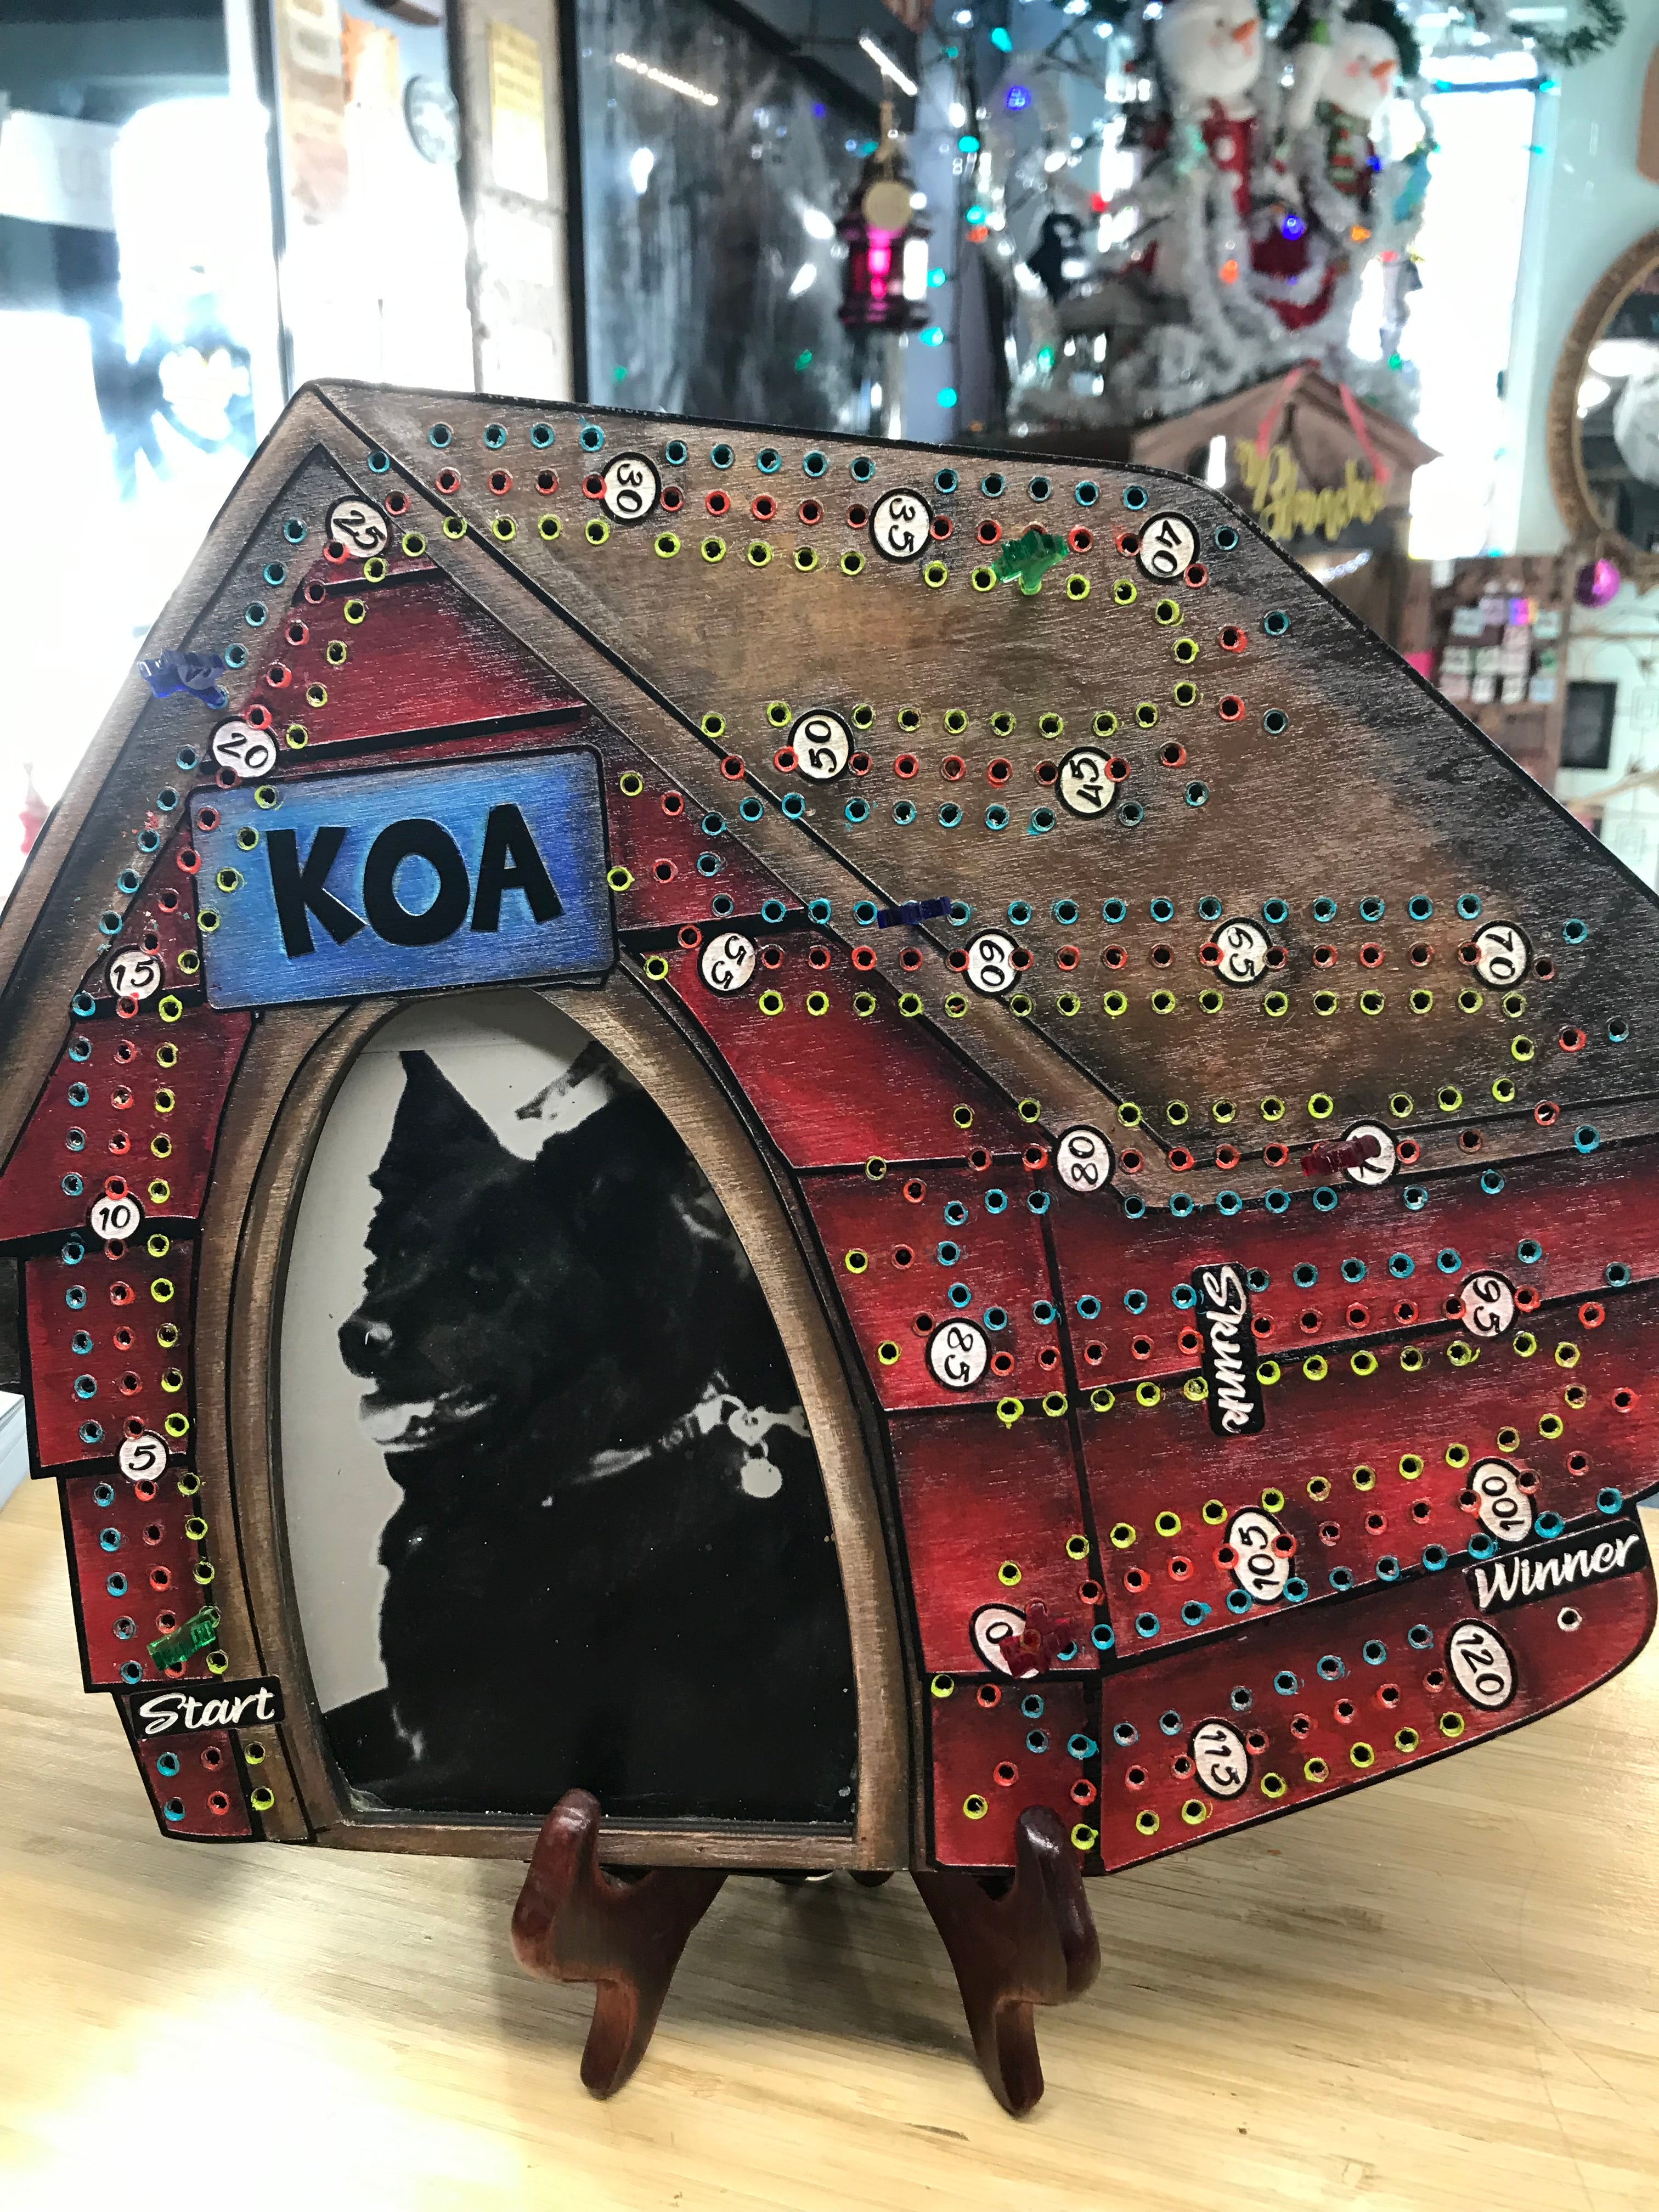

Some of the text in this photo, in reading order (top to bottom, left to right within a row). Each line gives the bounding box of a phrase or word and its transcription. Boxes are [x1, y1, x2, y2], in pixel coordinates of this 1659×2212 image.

[617, 464, 642, 512] 30
[333, 510, 386, 549] 25
[889, 498, 915, 552] 35
[1153, 520, 1182, 573] 40
[217, 732, 269, 768] 20
[805, 720, 837, 772] 50
[1069, 758, 1103, 808] 45
[267, 803, 564, 959] KOA
[114, 961, 154, 990] 15
[712, 935, 747, 989] 55
[979, 940, 1005, 986] 60
[1227, 927, 1254, 977] 65
[1486, 931, 1515, 978] 70
[1068, 1136, 1098, 1184] 80
[99, 1205, 131, 1230] 10
[1473, 1279, 1500, 1332] 95
[945, 1327, 973, 1382] 85
[1203, 1266, 1254, 1434] Skunk
[129, 1444, 156, 1470] 5
[1482, 1476, 1525, 1531] 100
[1238, 1526, 1279, 1589] 105
[1475, 1534, 1640, 1608] Winner
[1457, 1633, 1504, 1695] 120
[139, 1686, 274, 1734] Start
[1201, 1730, 1240, 1785] 115
